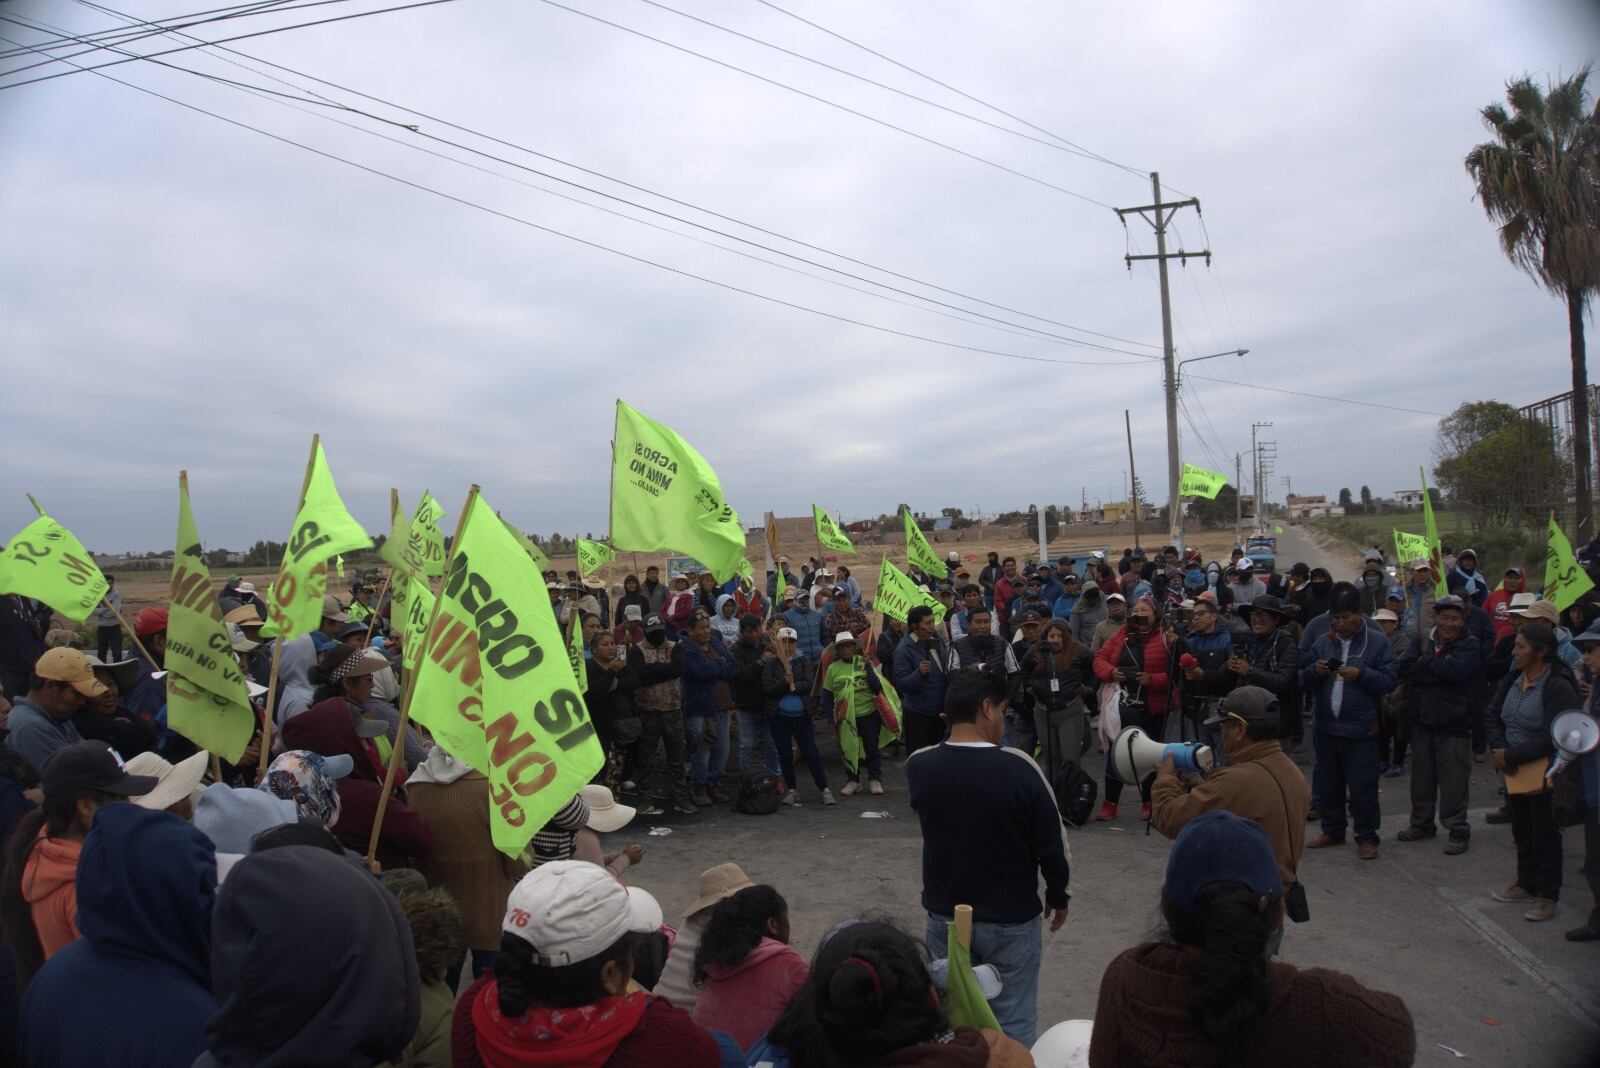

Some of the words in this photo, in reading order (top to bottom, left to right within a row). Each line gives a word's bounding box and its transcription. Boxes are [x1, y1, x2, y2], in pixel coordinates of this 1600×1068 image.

[196, 656, 217, 672] NO
[222, 667, 243, 686] VA
[534, 688, 596, 753] SI
[486, 711, 558, 798] NO
[509, 908, 532, 929] 76
